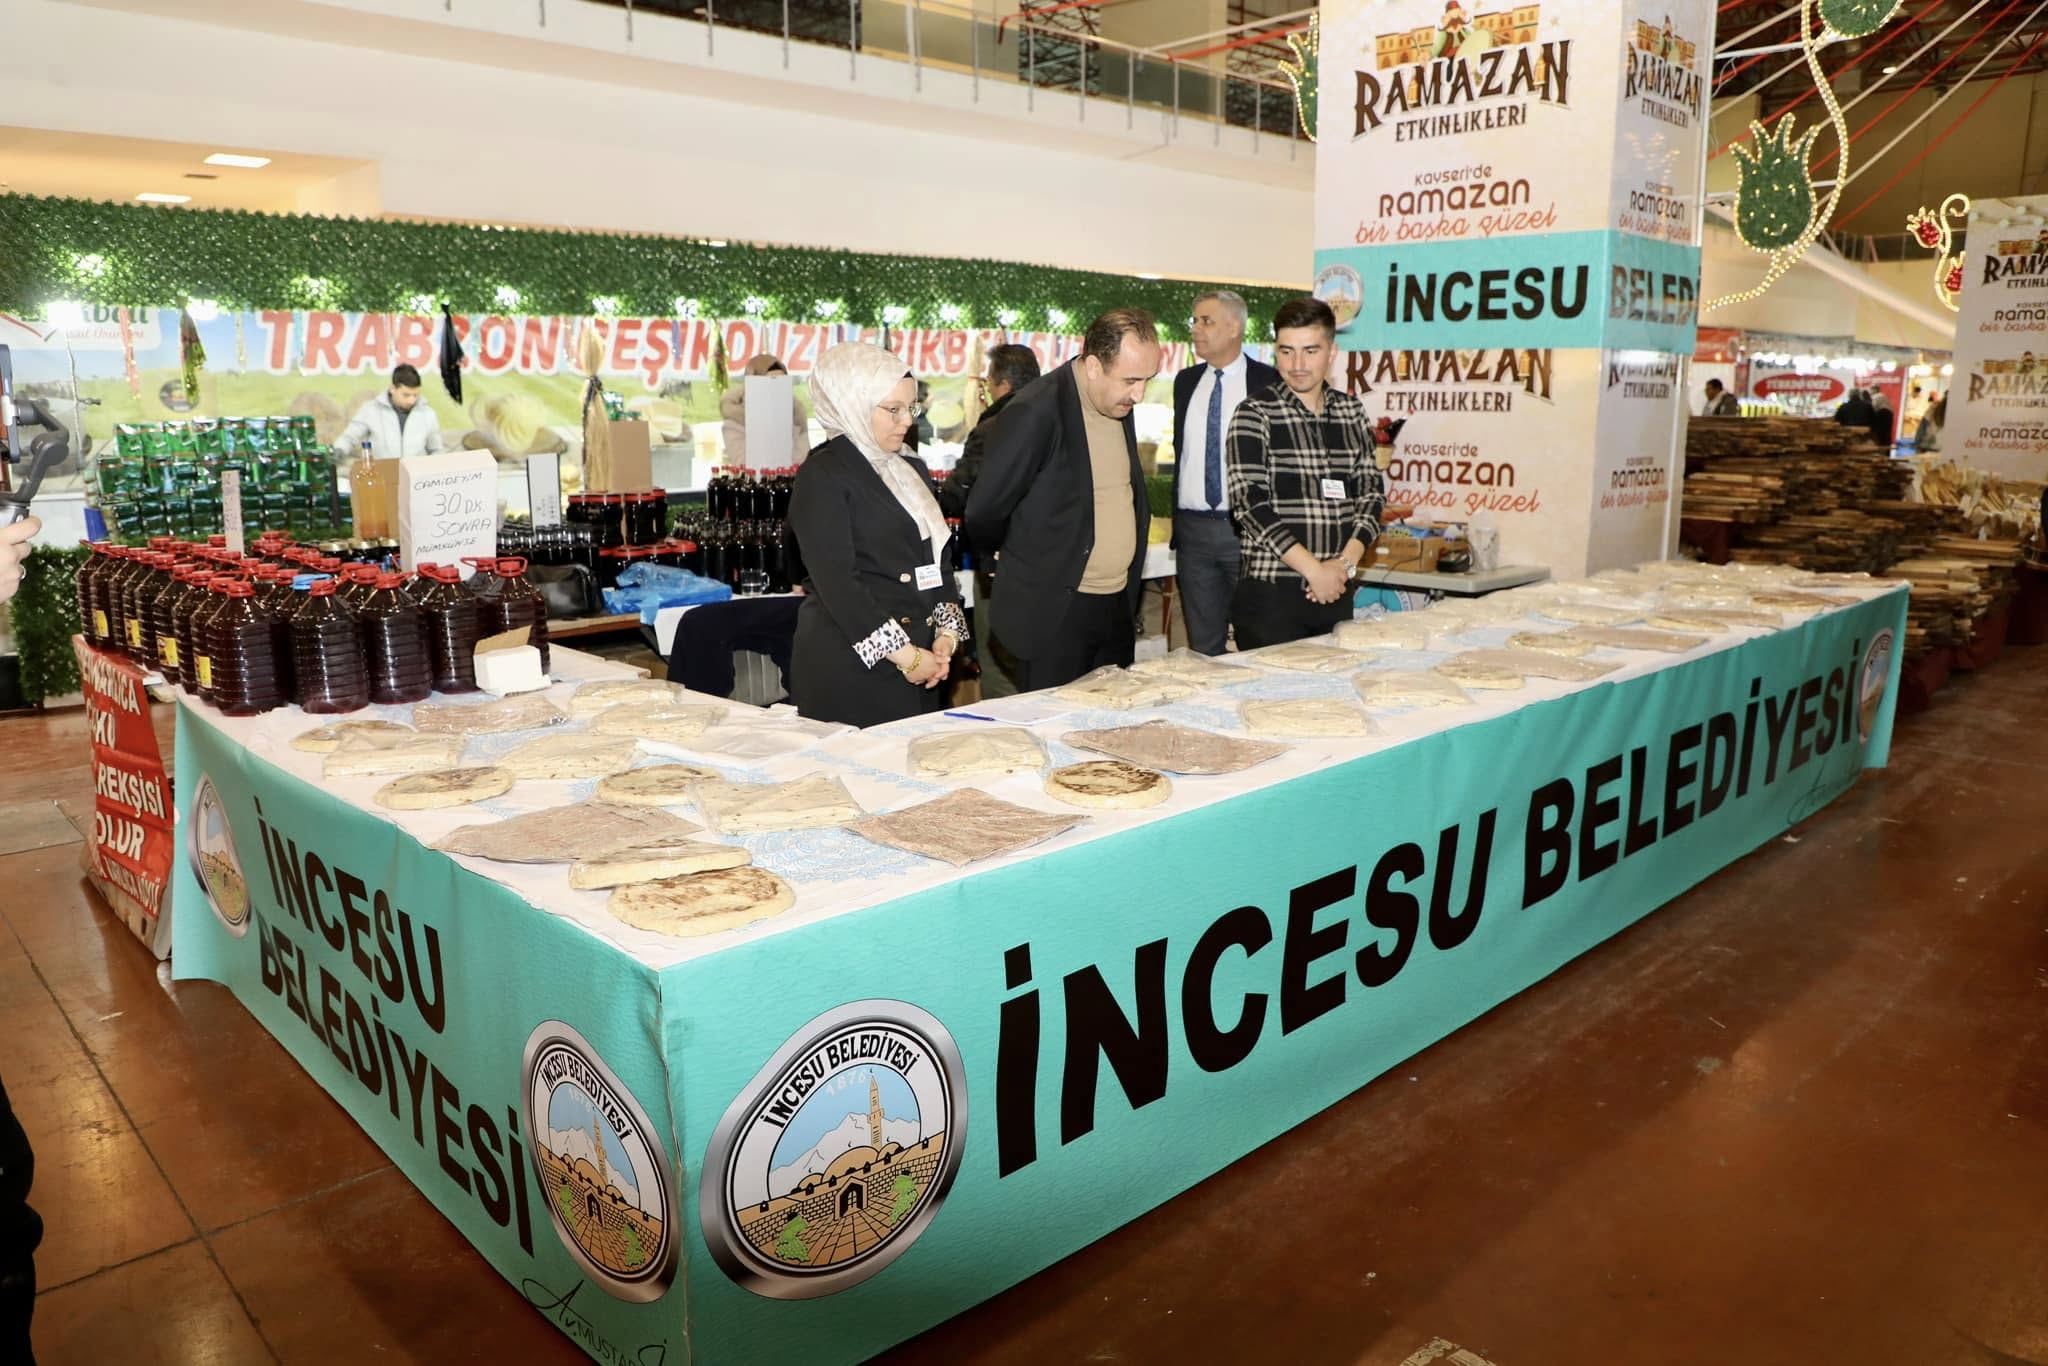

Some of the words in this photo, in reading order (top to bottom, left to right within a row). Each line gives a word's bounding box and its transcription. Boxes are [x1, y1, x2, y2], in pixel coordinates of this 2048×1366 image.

[1386, 262, 1589, 323] İNCESU
[1385, 391, 1512, 412] ETKİNLİKLERİ
[431, 492, 462, 517] 30
[431, 518, 492, 538] SONRA
[253, 795, 446, 1035] İNCESU
[997, 809, 1497, 1179] İNCESU
[1522, 637, 1861, 911] BELEDİYESİ
[255, 907, 535, 1259] BELEDİYESİ
[540, 1053, 568, 1093] İNCESU
[566, 1053, 633, 1141] BELEDİYESİ
[760, 1054, 825, 1129] İNCESU
[826, 1032, 921, 1076] BELEDİYESİ
